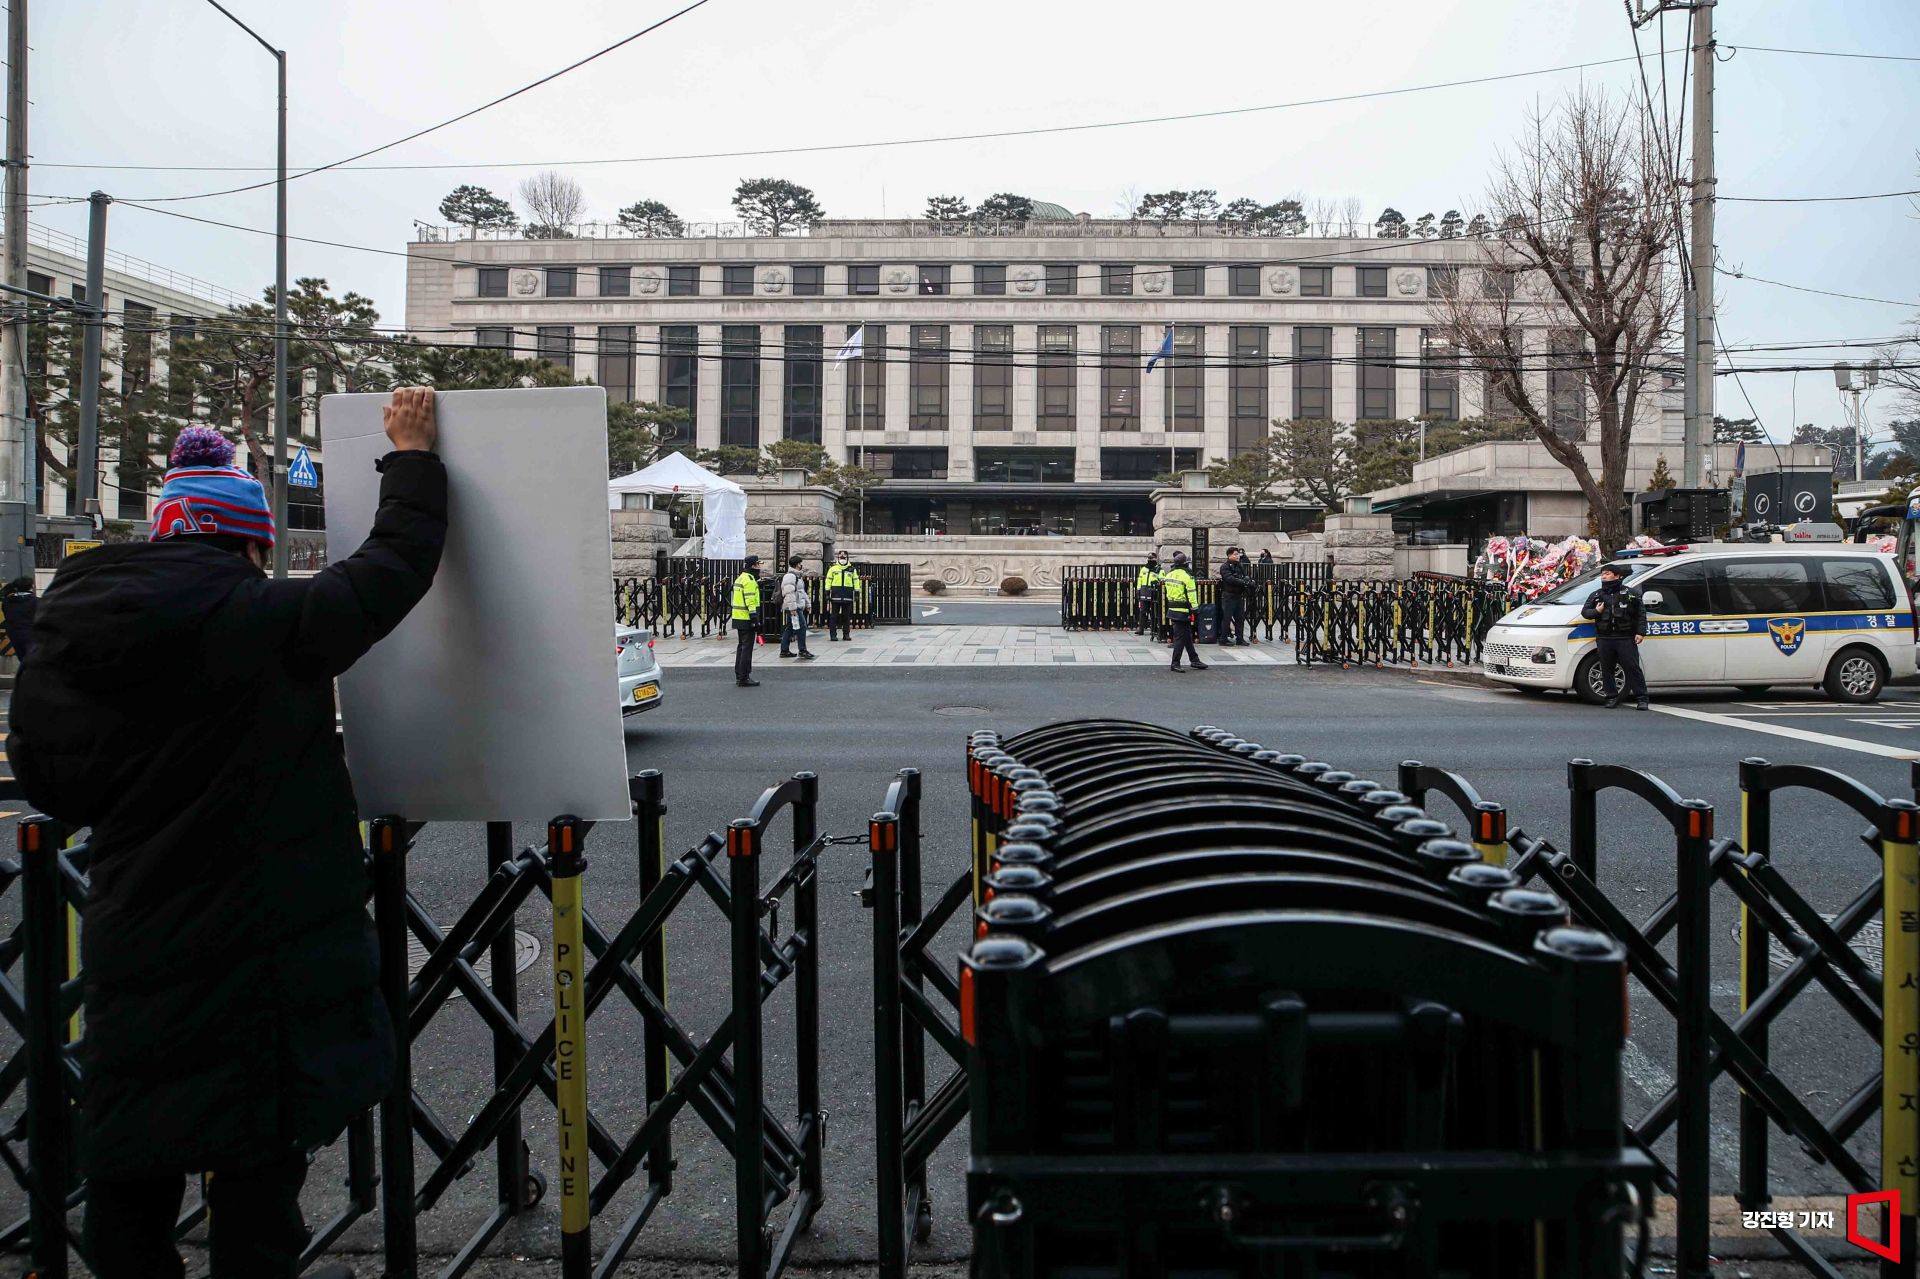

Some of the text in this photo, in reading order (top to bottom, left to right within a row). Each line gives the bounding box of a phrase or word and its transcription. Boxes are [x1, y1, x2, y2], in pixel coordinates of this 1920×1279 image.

[1682, 622, 1695, 633] 82
[556, 943, 575, 1196] POLICE LINE
